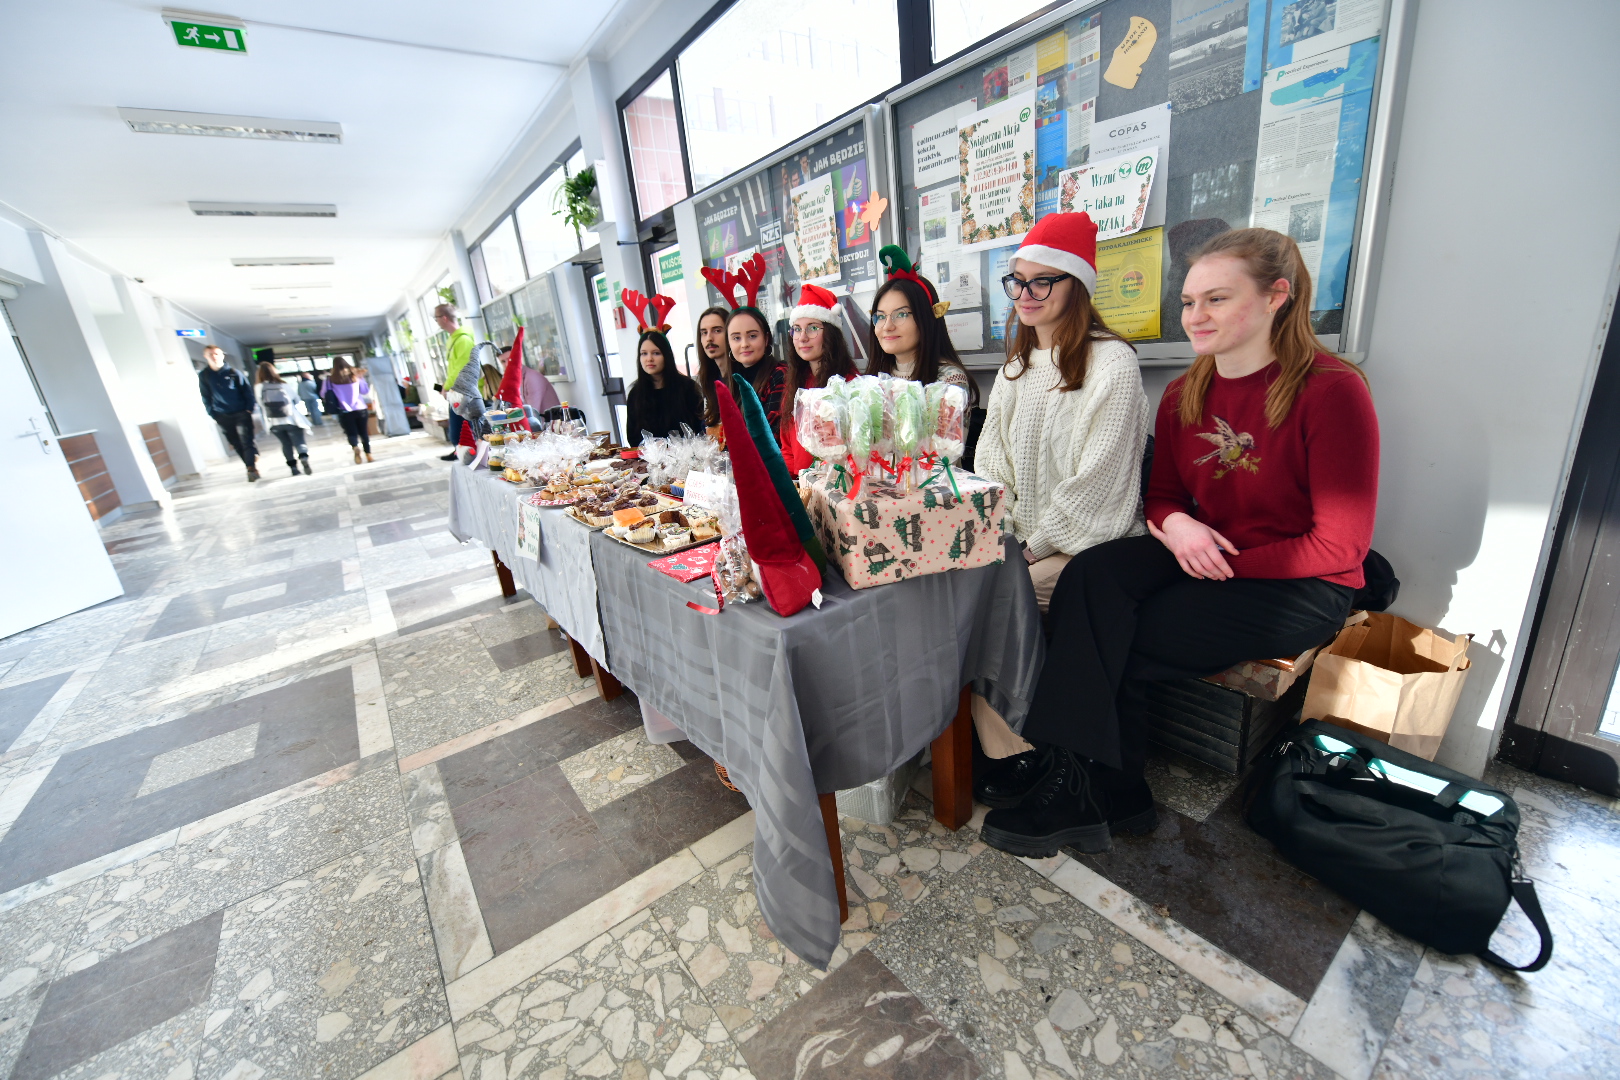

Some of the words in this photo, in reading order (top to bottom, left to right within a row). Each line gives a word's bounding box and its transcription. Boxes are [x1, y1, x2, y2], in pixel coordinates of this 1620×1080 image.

[1123, 26, 1148, 55] HOLAND
[1108, 121, 1148, 139] COPAS
[813, 155, 829, 173] JAK
[830, 140, 866, 165] BĘDZIE
[1091, 168, 1117, 188] Wrzuć
[1115, 194, 1125, 206] na
[703, 214, 713, 226] JAK
[713, 205, 738, 222] BĘDZIE?
[1094, 214, 1125, 233] RZAKA
[762, 227, 781, 244] NZS
